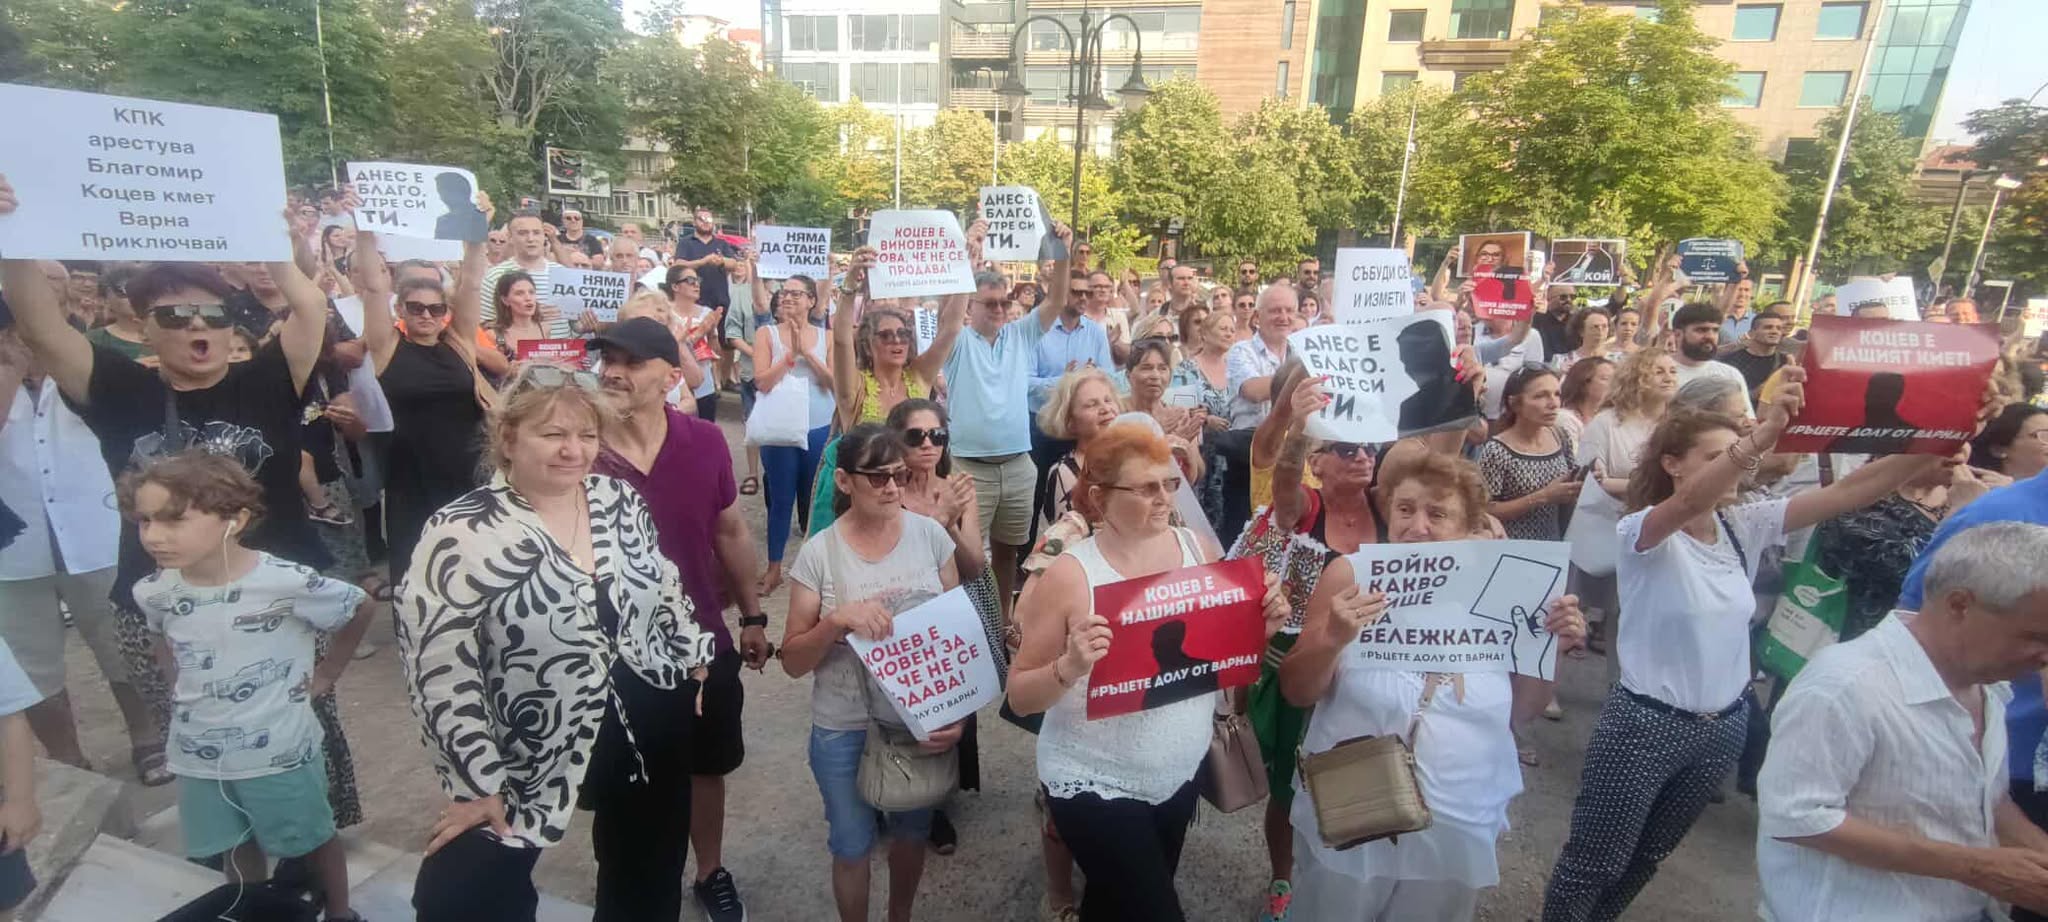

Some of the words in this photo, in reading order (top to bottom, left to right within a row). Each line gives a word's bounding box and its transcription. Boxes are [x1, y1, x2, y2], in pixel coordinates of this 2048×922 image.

[113, 107, 165, 127] КПК
[88, 134, 195, 155] арестува
[87, 157, 203, 181] Благомир
[356, 169, 407, 182] ДНЕС
[414, 172, 424, 183] Е
[82, 183, 155, 202] Коцев
[163, 191, 215, 205] кмет
[358, 184, 426, 198] БЛАГО.
[360, 197, 398, 208] УТРЕ
[403, 199, 426, 209] СИ
[985, 194, 1024, 206] ДНЕС
[1028, 194, 1033, 204] Е
[120, 211, 189, 228] Варна
[361, 210, 408, 227] ТИ.
[1018, 221, 1035, 230] СИ
[786, 231, 826, 243] НЯМА
[895, 227, 935, 238] КОЦЕВ
[939, 227, 945, 237] Е
[82, 232, 227, 251] Приключвай
[761, 242, 781, 255] ДА
[783, 243, 826, 254] СТАНЕ
[881, 240, 939, 251] ВИНОВЕН
[942, 240, 956, 249] ЗА
[986, 233, 1020, 249] ТИ.
[787, 255, 826, 266] ТАКА!
[912, 252, 927, 261] ЧЕ
[930, 252, 945, 262] НЕ
[948, 251, 964, 261] СЕ
[889, 264, 951, 276] ПРОДАВА!
[1352, 265, 1395, 283] СЪБУДИ
[1397, 267, 1408, 281] СЕ
[583, 275, 625, 288] НЯМА
[552, 284, 576, 296] ДА
[579, 286, 625, 299] СТАНЕ
[1353, 294, 1362, 308] И
[1364, 292, 1406, 308] ИЗМЕТИ
[1304, 334, 1359, 353] ДНЕС
[1368, 335, 1381, 352] Е
[1859, 331, 1921, 348] КОЦЕВ
[1926, 334, 1936, 348] Е
[1310, 354, 1385, 374] БЛАГО.
[1833, 346, 1910, 366] НАШИЯТ
[1917, 351, 1971, 367] КМЕТ!
[1359, 379, 1385, 393] СИ
[1848, 426, 1891, 438] ДОЛУ
[1894, 428, 1916, 439] ОТ
[1144, 578, 1200, 603] КОЦЕВ
[1205, 576, 1215, 589] Е
[1368, 575, 1447, 594] КАКВО
[1121, 597, 1195, 626] НАШИЯТ
[1200, 587, 1246, 609] КМЕТ!
[928, 625, 940, 641] Е
[1359, 628, 1514, 646] БЕЛЕЖКАТА?
[941, 634, 965, 654] ЗА
[897, 669, 923, 687] ЧЕ
[927, 657, 953, 678] НЕ
[957, 644, 979, 665] СЕ
[1413, 653, 1446, 663] ДОЛУ
[1449, 653, 1463, 662] ОТ
[1465, 653, 1505, 663] ВАРНА!
[1090, 677, 1151, 698] #РЪЦЕТЕ
[1154, 667, 1190, 688] ДОЛУ
[1192, 664, 1209, 676] ОТ
[1211, 654, 1258, 671] ВАРНА!
[932, 703, 945, 713] ОТ
[947, 687, 979, 708] ВАРНА!
